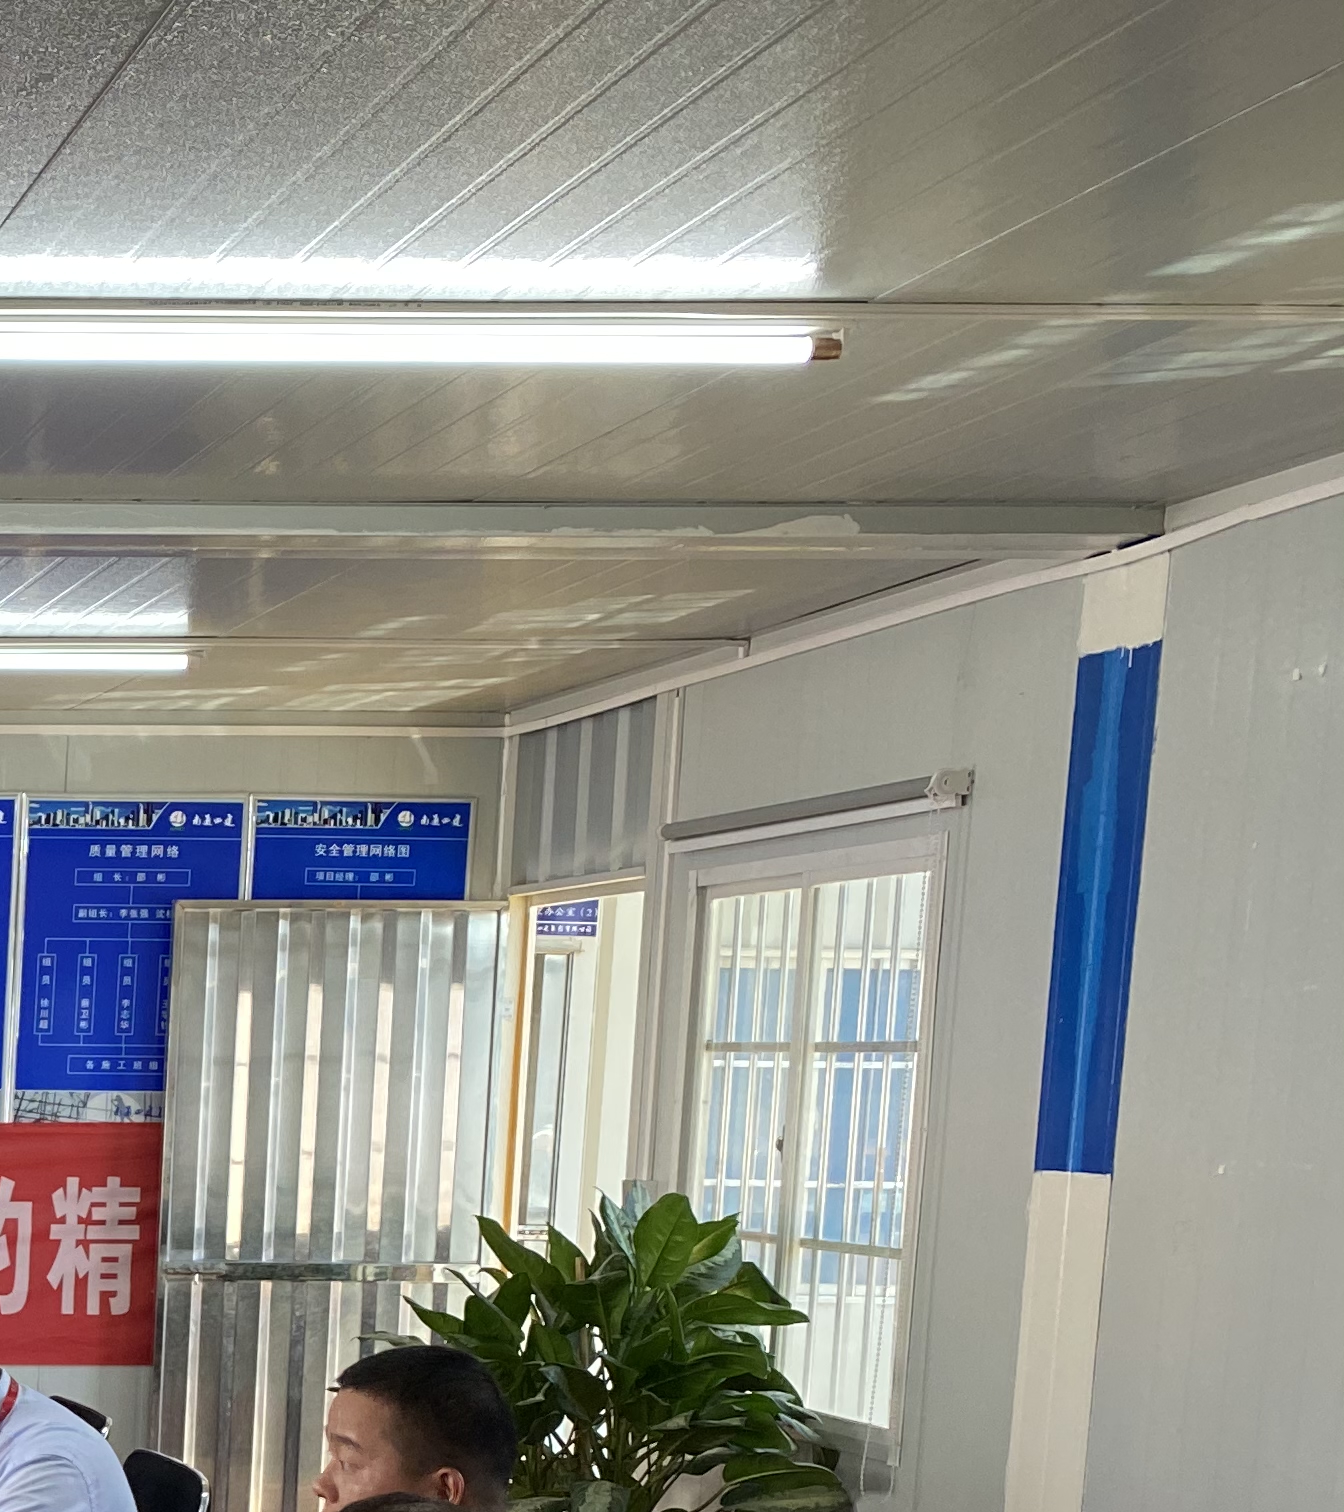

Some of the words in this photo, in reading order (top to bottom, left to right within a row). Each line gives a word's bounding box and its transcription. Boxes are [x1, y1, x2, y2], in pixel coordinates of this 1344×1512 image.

[89, 844, 179, 858] 质量管理网络
[314, 843, 410, 858] 安全管理网络图
